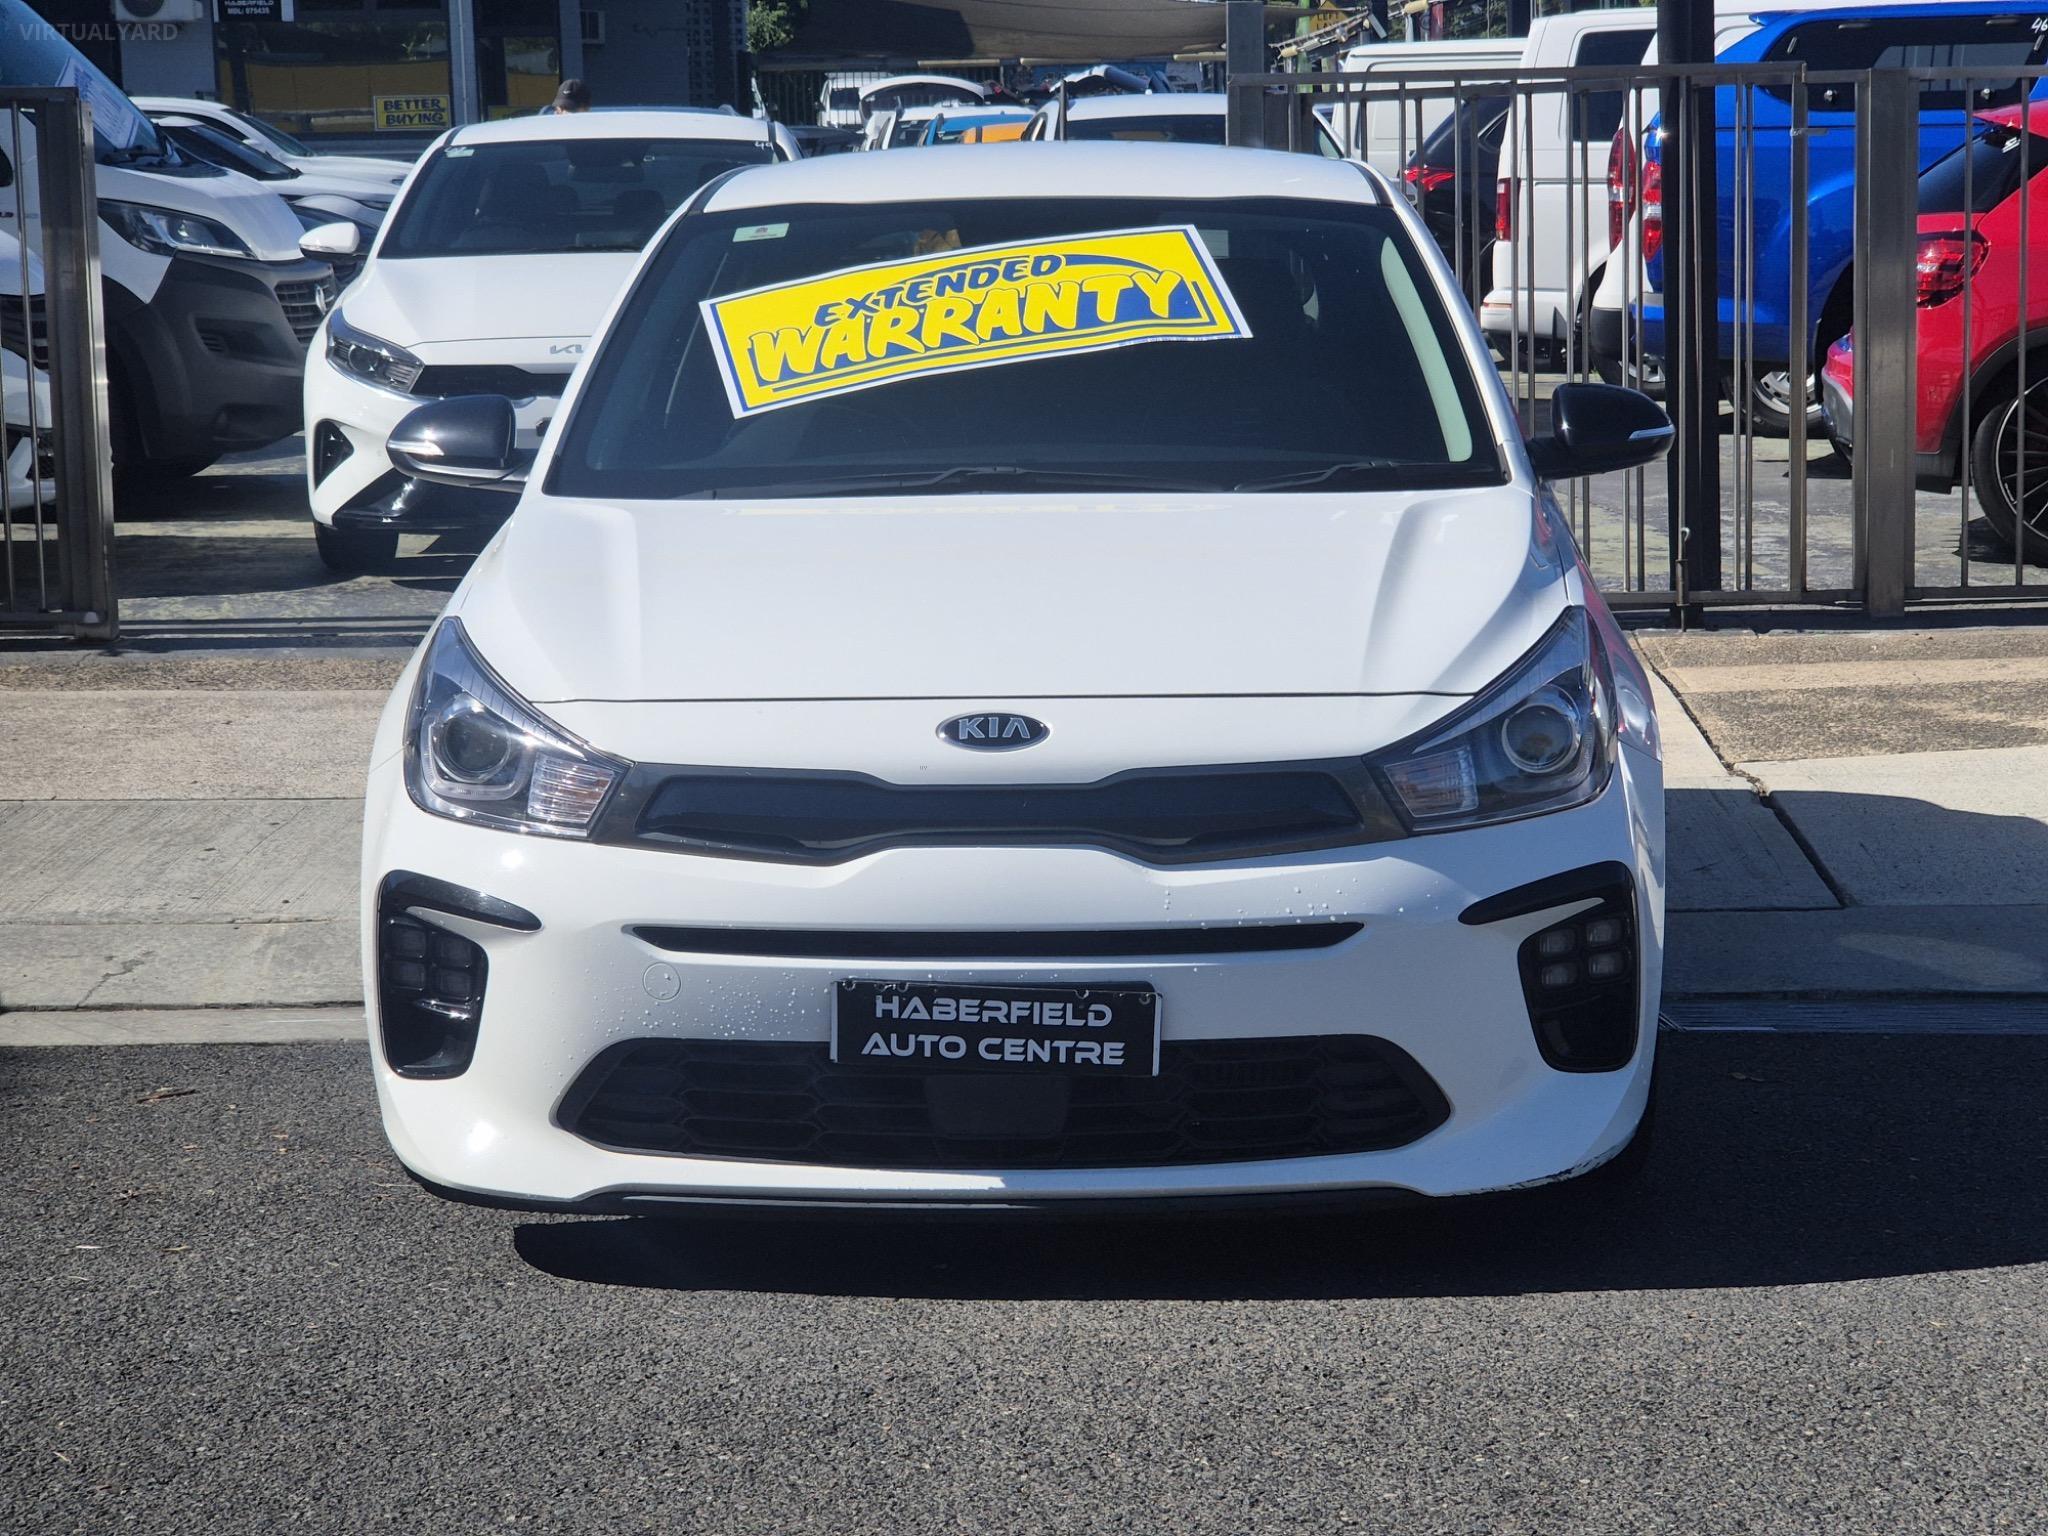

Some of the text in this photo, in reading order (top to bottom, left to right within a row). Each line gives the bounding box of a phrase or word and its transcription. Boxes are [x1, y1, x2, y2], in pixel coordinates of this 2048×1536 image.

[383, 99, 445, 112] BETTER
[385, 112, 446, 126] BUYING
[814, 254, 1066, 328] EXTENDED
[748, 269, 1184, 382] WARRANTY
[958, 717, 1031, 740] KIA
[875, 995, 1113, 1027] HABERFIELD
[861, 1032, 1126, 1065] AUTO CENTRE
